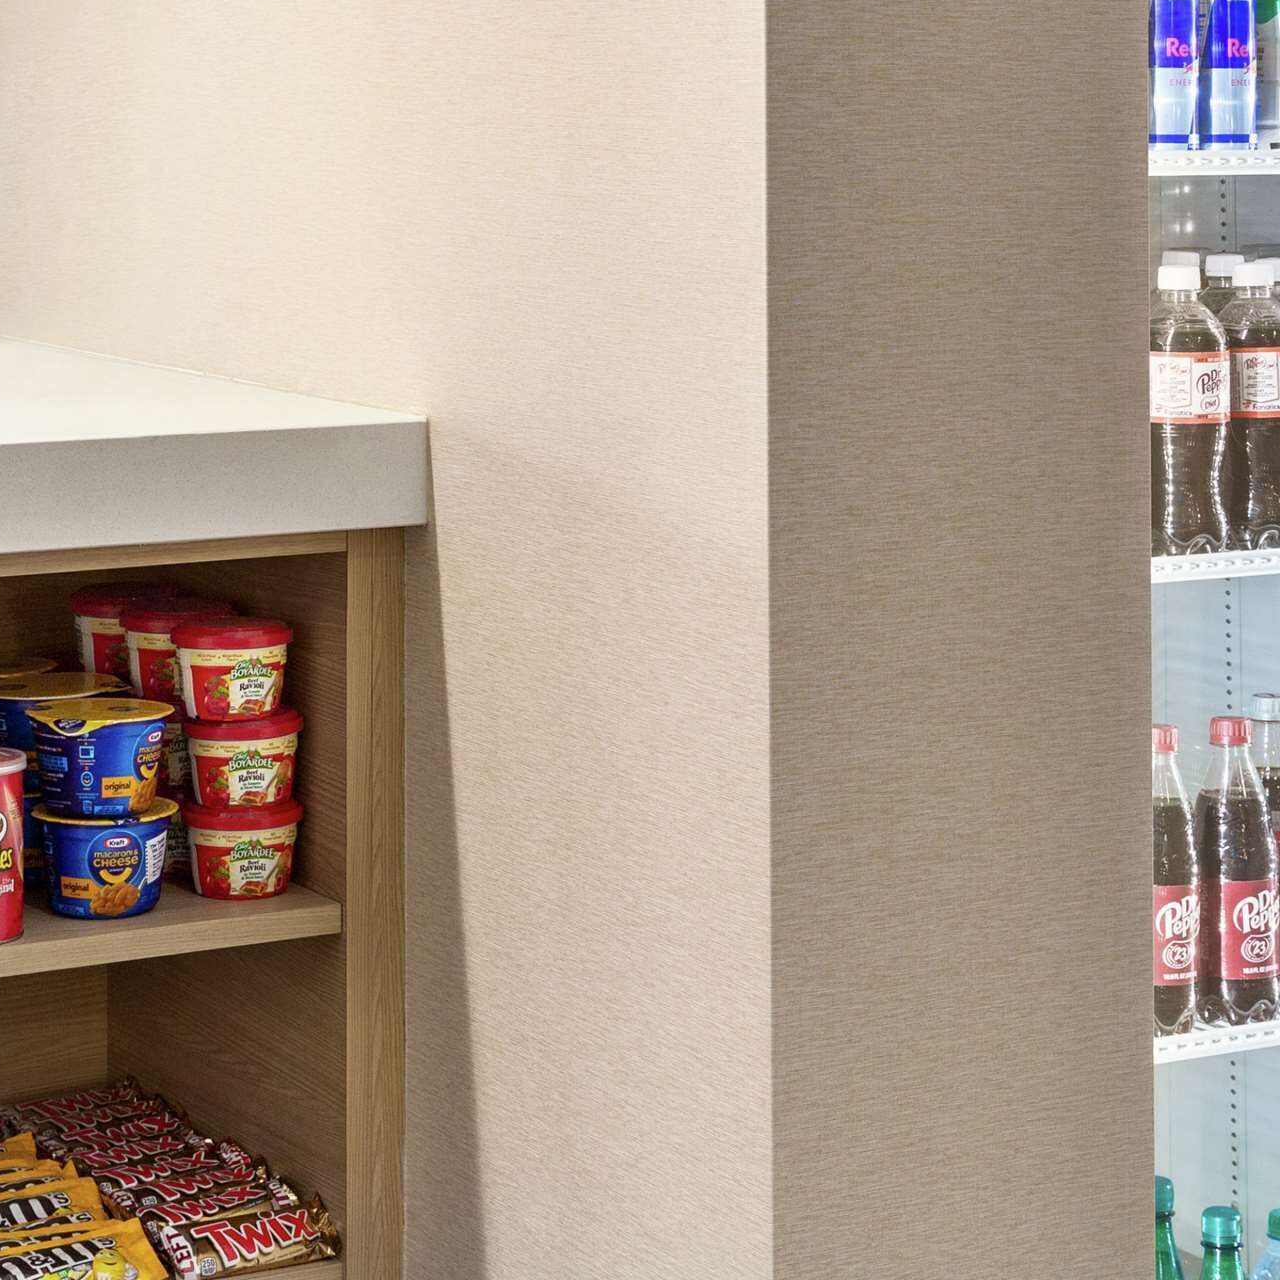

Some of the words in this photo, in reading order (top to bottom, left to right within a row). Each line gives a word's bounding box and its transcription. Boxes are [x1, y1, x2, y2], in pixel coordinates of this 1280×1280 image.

[231, 666, 272, 679] BOYARDEE
[239, 681, 265, 692] Ravioli
[229, 758, 273, 770] BOYARDEE
[238, 773, 265, 783] Ravioli
[104, 780, 131, 793] original
[108, 839, 125, 848] Kraft
[230, 847, 274, 860] BOYARDEE
[1252, 940, 1266, 954] 23
[91, 1151, 220, 1189] Twix
[136, 1185, 268, 1227] Twix
[190, 1209, 317, 1270] Twix
[166, 1233, 195, 1274] LEFT
